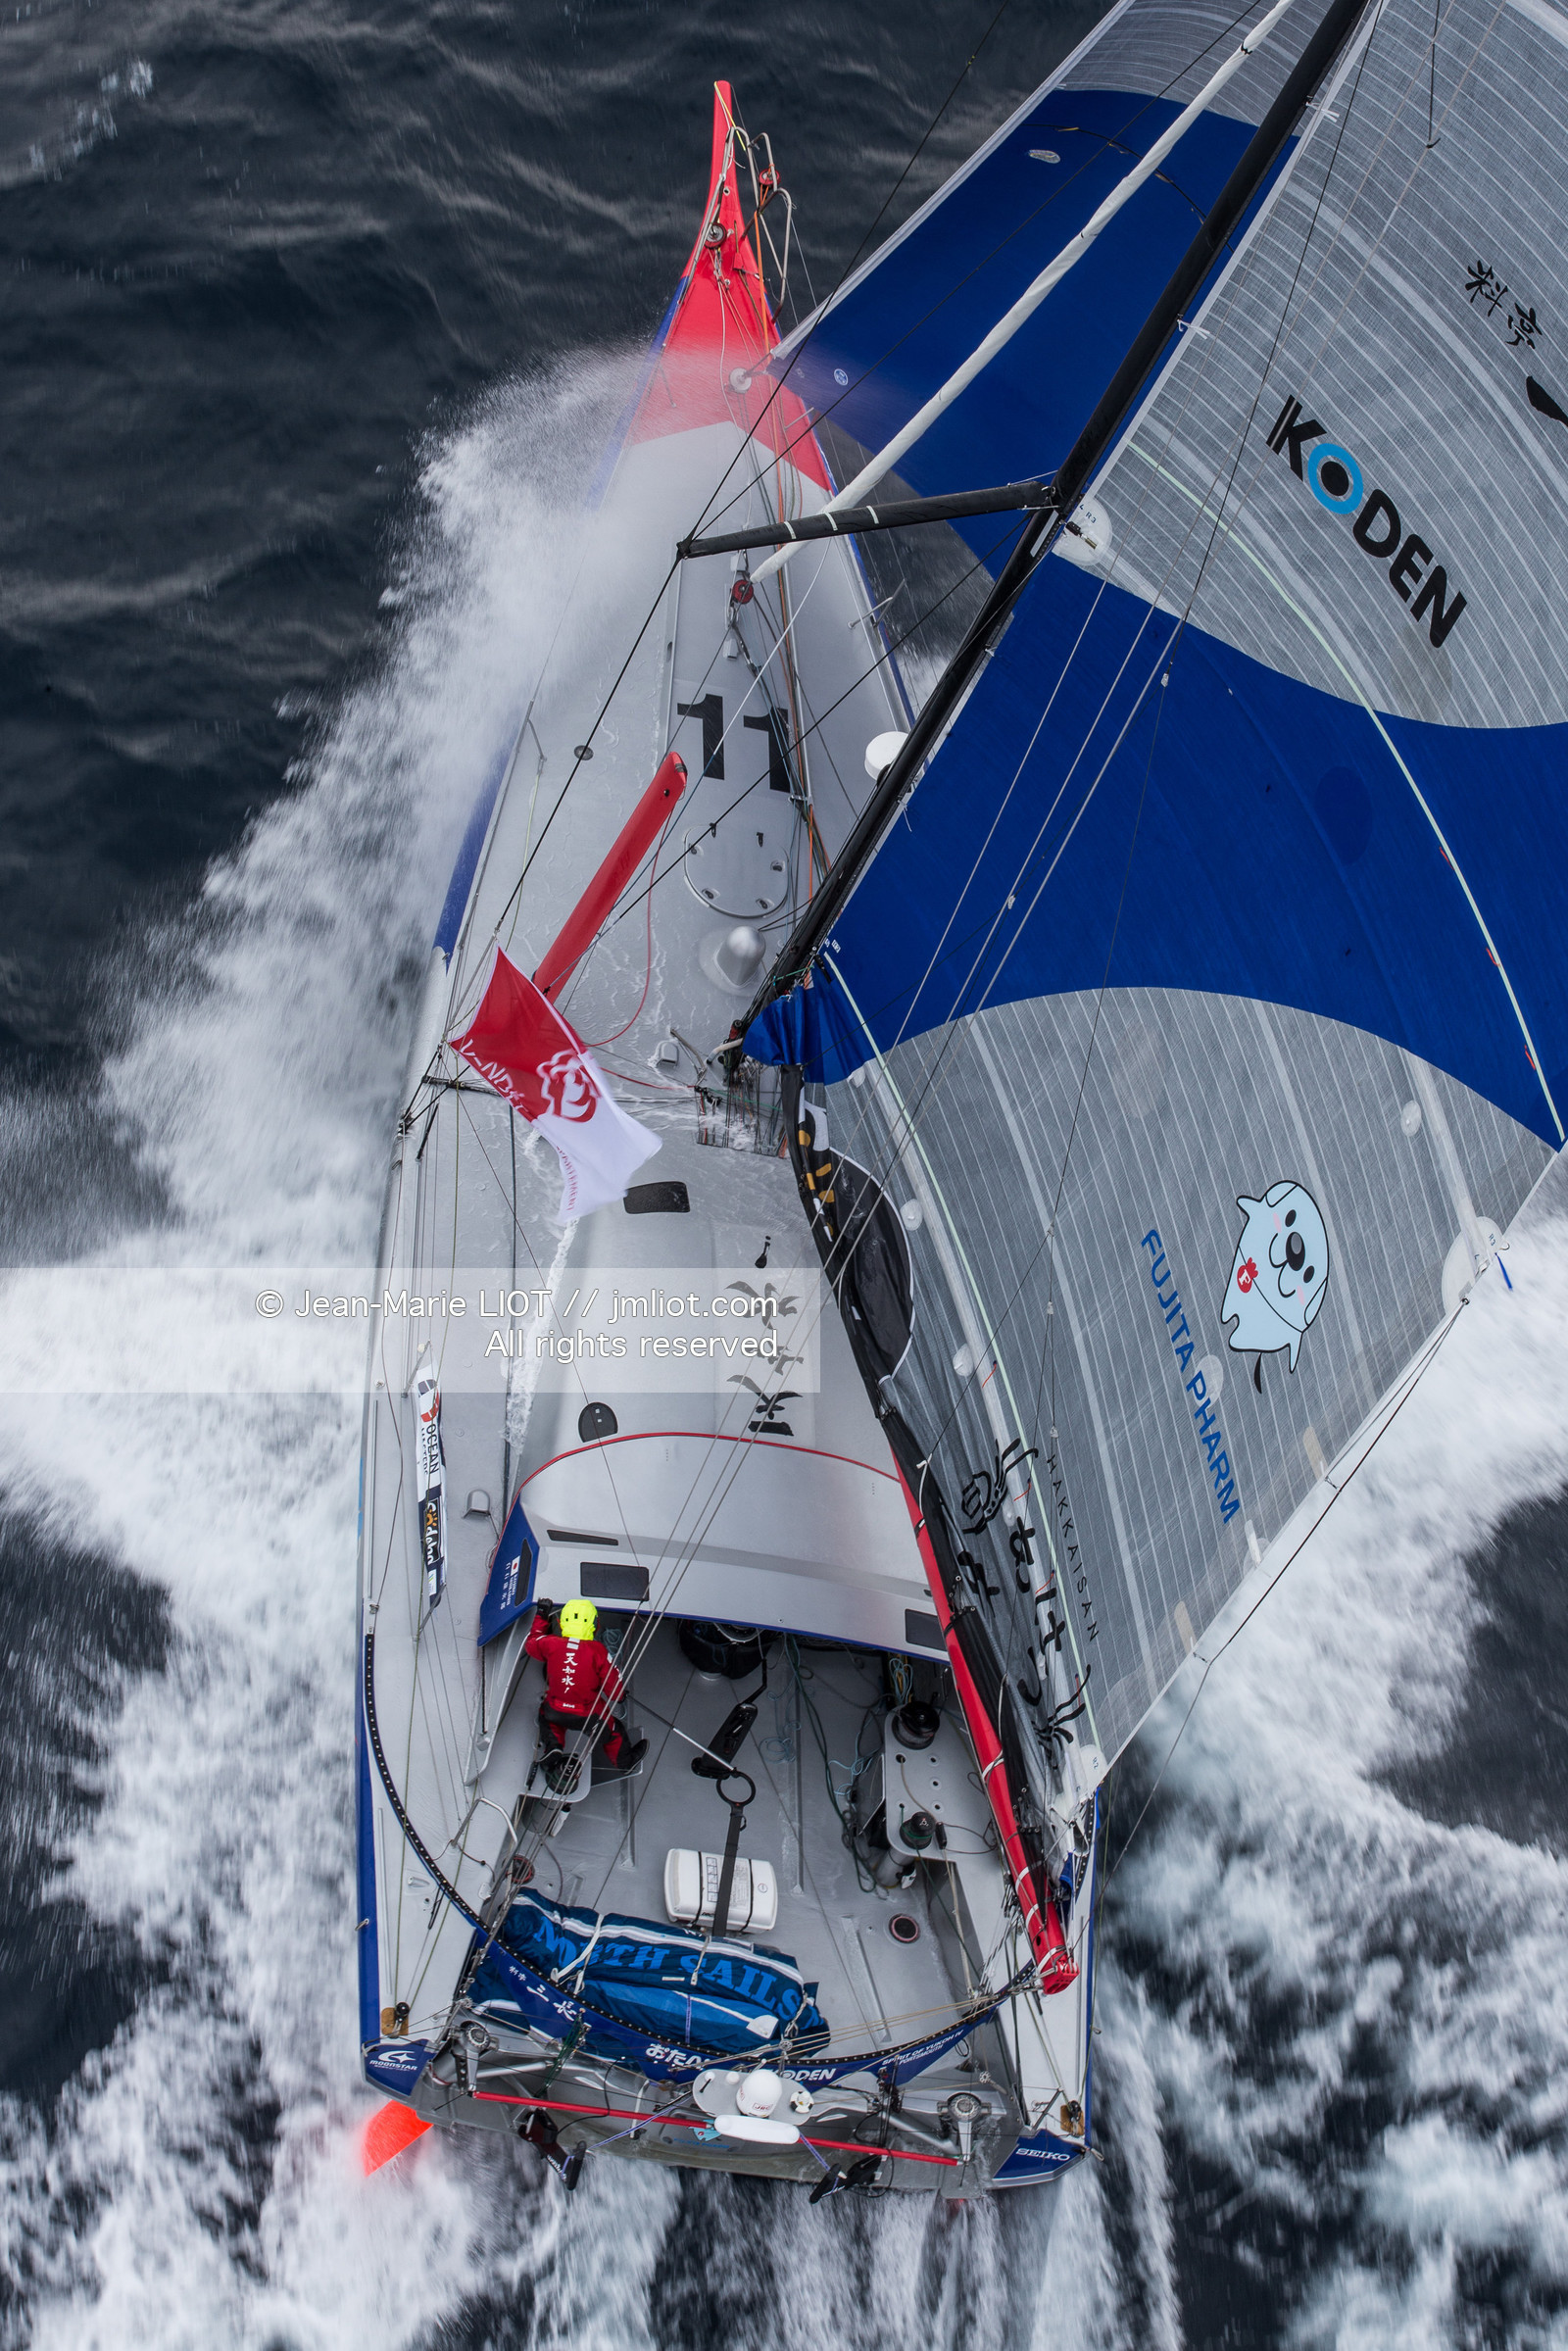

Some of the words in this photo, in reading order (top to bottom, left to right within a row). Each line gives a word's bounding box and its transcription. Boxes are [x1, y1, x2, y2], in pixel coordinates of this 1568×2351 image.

[1465, 260, 1544, 349] 料亭
[1265, 395, 1468, 649] KODEN
[677, 693, 791, 794] 11
[1141, 1229, 1195, 1373] FUJITA
[1185, 1371, 1241, 1524] PHARM
[425, 1423, 440, 1475] OCEAN
[1046, 1453, 1099, 1641] HAKKAISAN
[678, 1954, 802, 2021] SAILS
[1015, 2147, 1071, 2162] SEIKO
